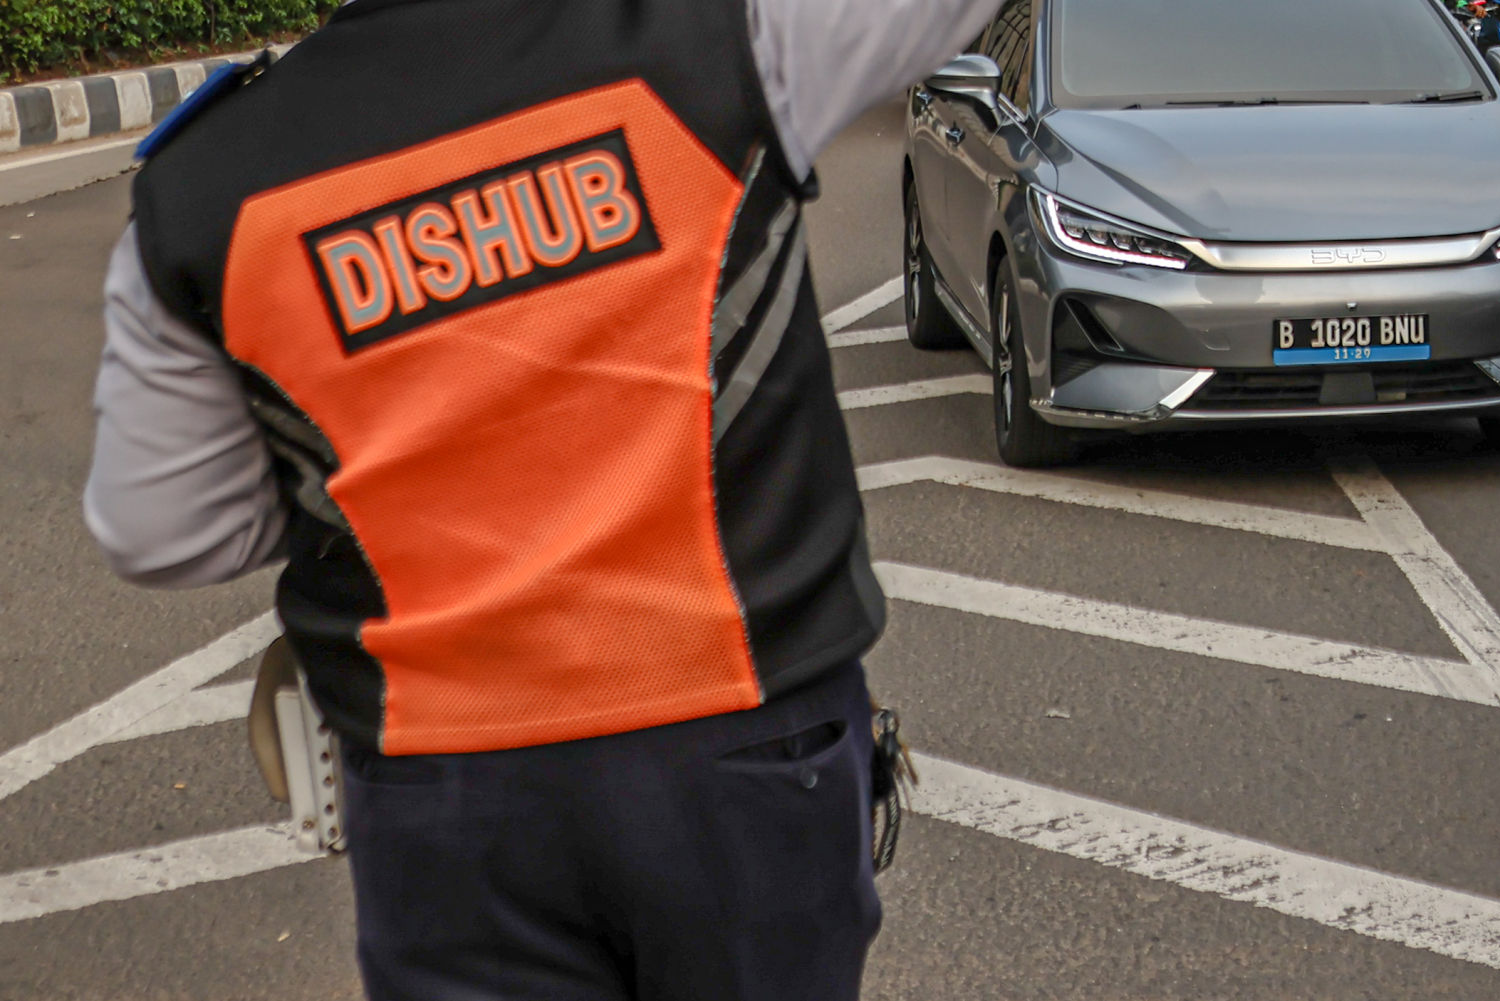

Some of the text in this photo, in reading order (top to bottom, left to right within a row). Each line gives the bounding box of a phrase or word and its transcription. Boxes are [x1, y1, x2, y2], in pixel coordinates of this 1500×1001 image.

[316, 149, 642, 336] DISHUB
[1311, 247, 1386, 265] BYD
[1279, 315, 1425, 349] B 1020 BNU
